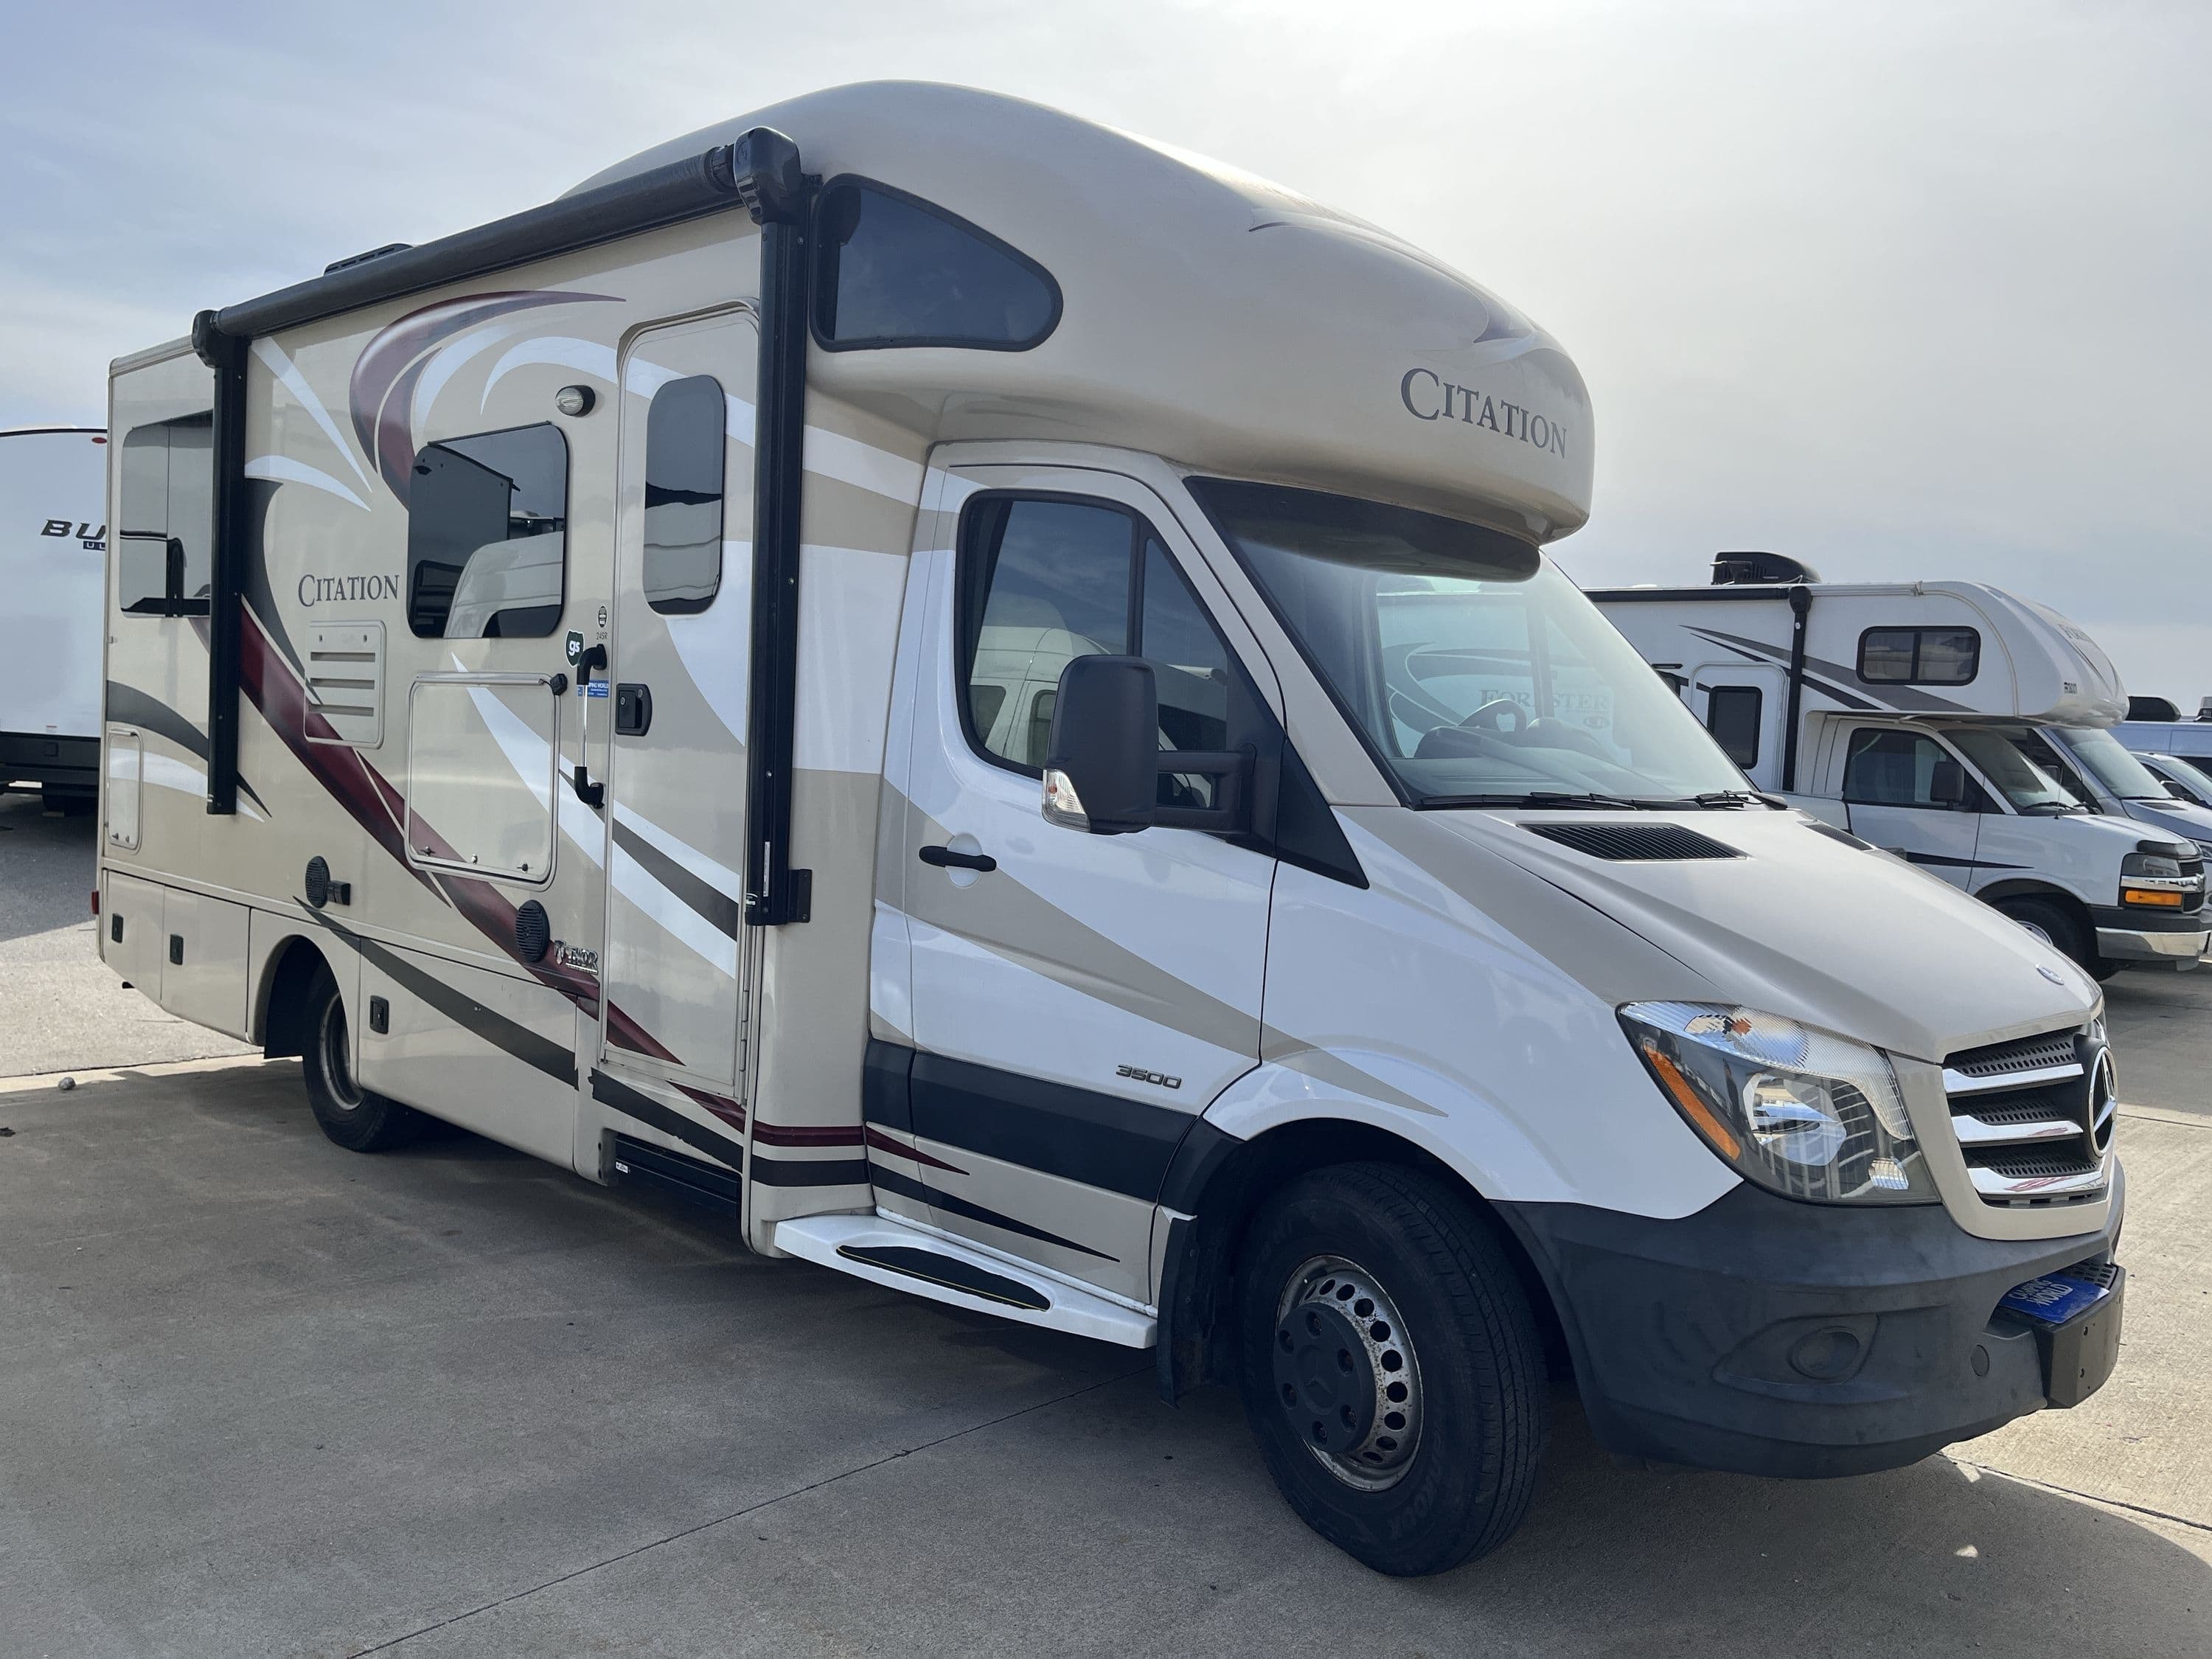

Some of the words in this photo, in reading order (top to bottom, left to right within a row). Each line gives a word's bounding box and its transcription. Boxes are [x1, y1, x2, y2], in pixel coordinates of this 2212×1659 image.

[1400, 367, 1567, 459] CITATION
[298, 574, 400, 607] CITATION
[568, 639, 580, 656] gs
[1116, 1064, 1182, 1090] 3500
